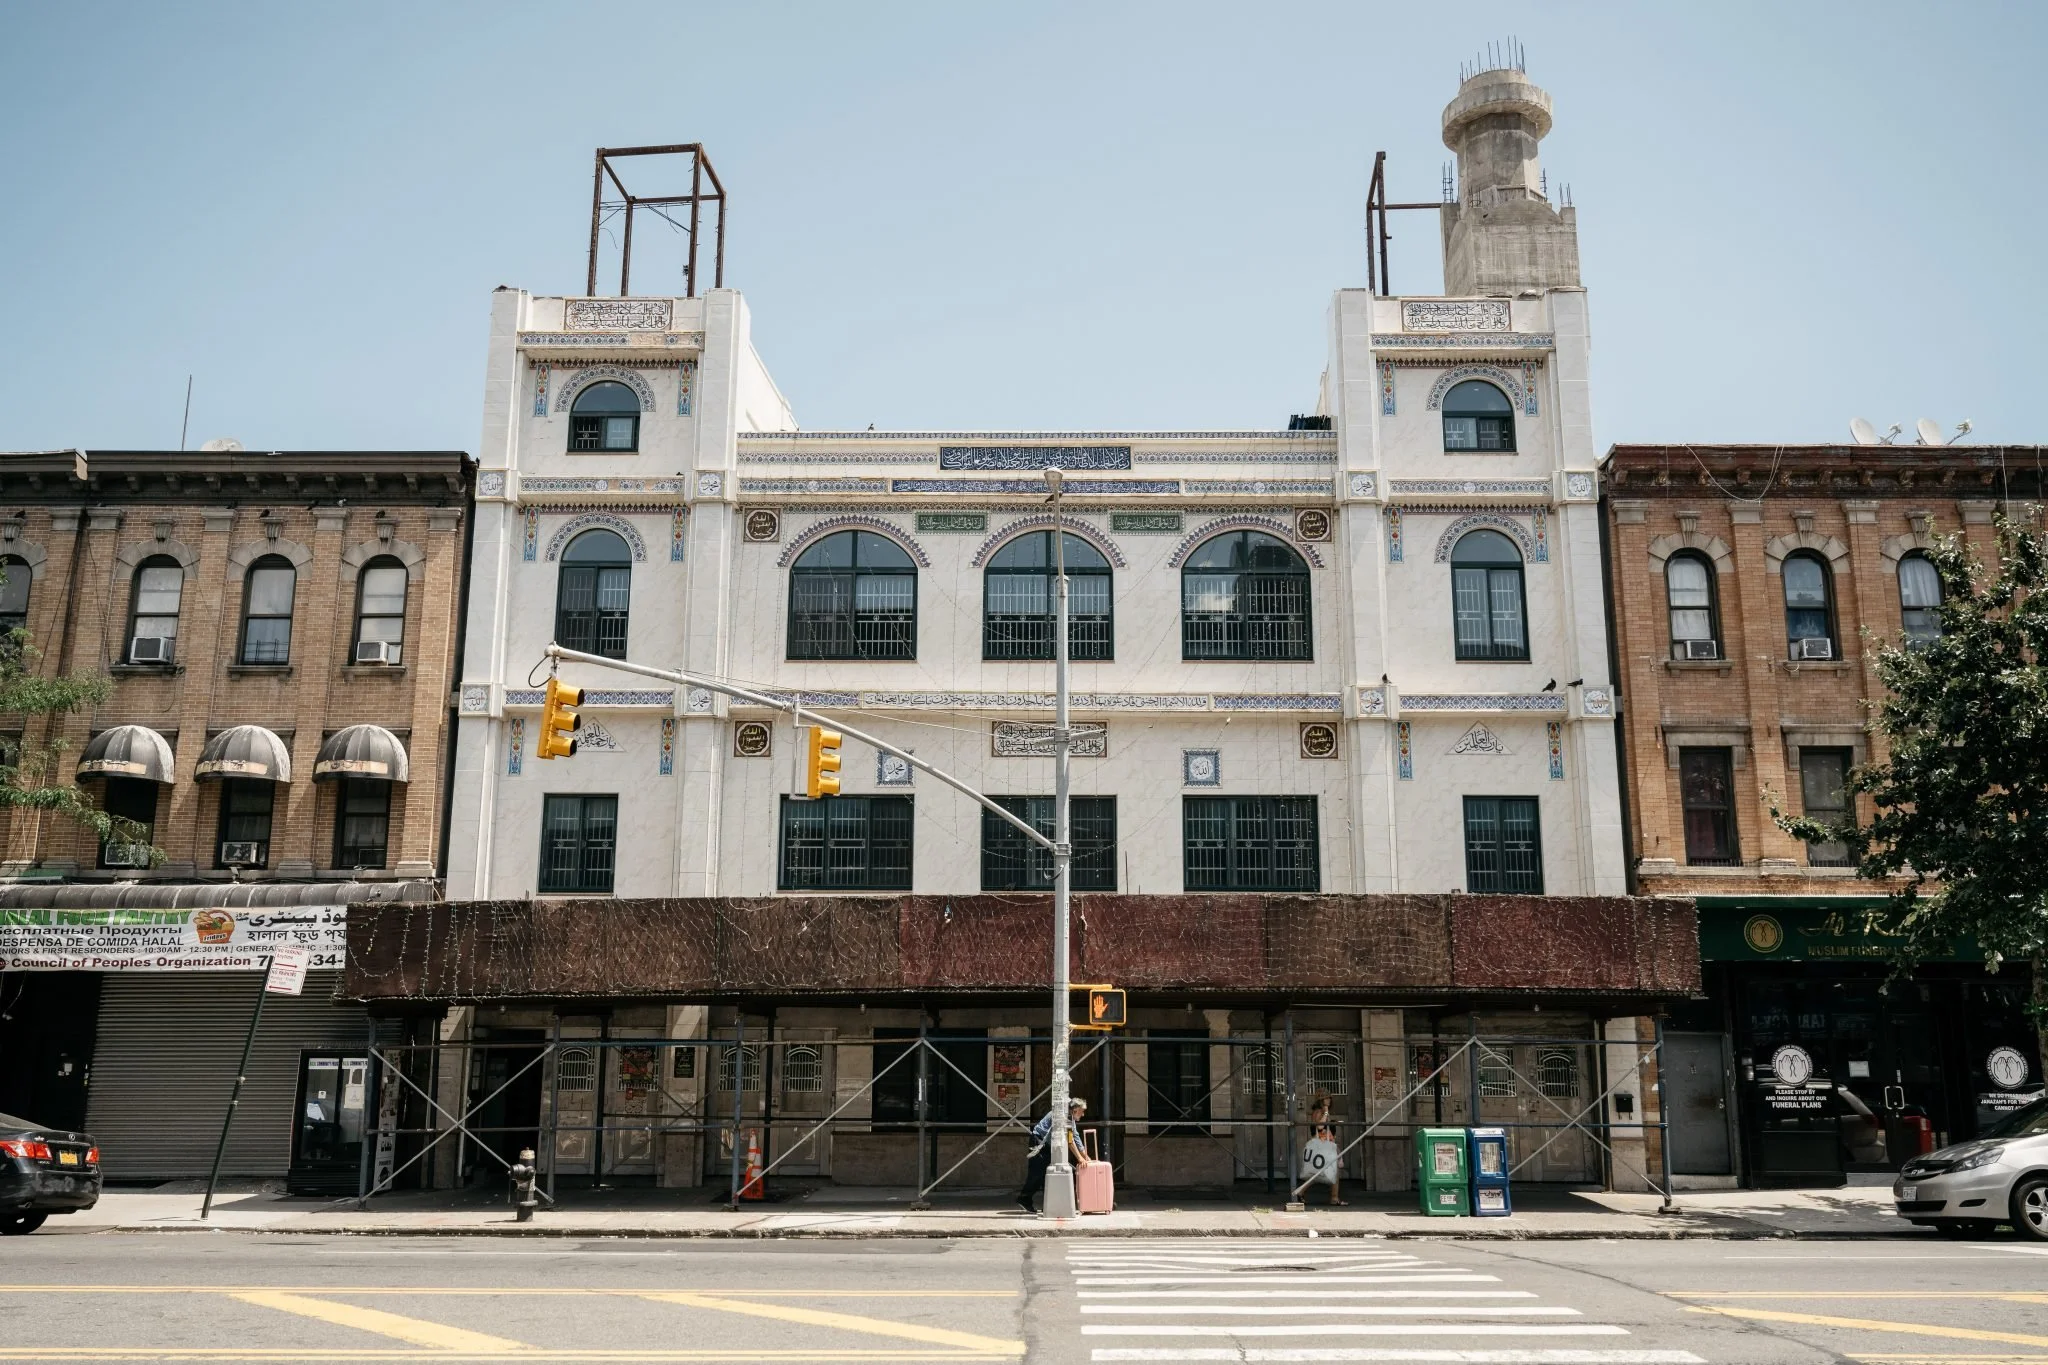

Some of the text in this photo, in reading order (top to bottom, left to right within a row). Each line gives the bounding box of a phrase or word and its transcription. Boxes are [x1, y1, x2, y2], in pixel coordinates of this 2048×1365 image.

[57, 910, 110, 925] FOOD
[113, 910, 192, 925] PANTRY
[99, 926, 182, 936] Продукты
[0, 937, 184, 947] ESPENSA DE COMIDA HALAL
[1808, 946, 1848, 956] MUSLIM
[12, 957, 67, 968] Council
[72, 957, 88, 968] of
[92, 957, 151, 970] Peoples
[157, 956, 251, 969] Organization
[1772, 1101, 1822, 1109] FUNERAL PLANS
